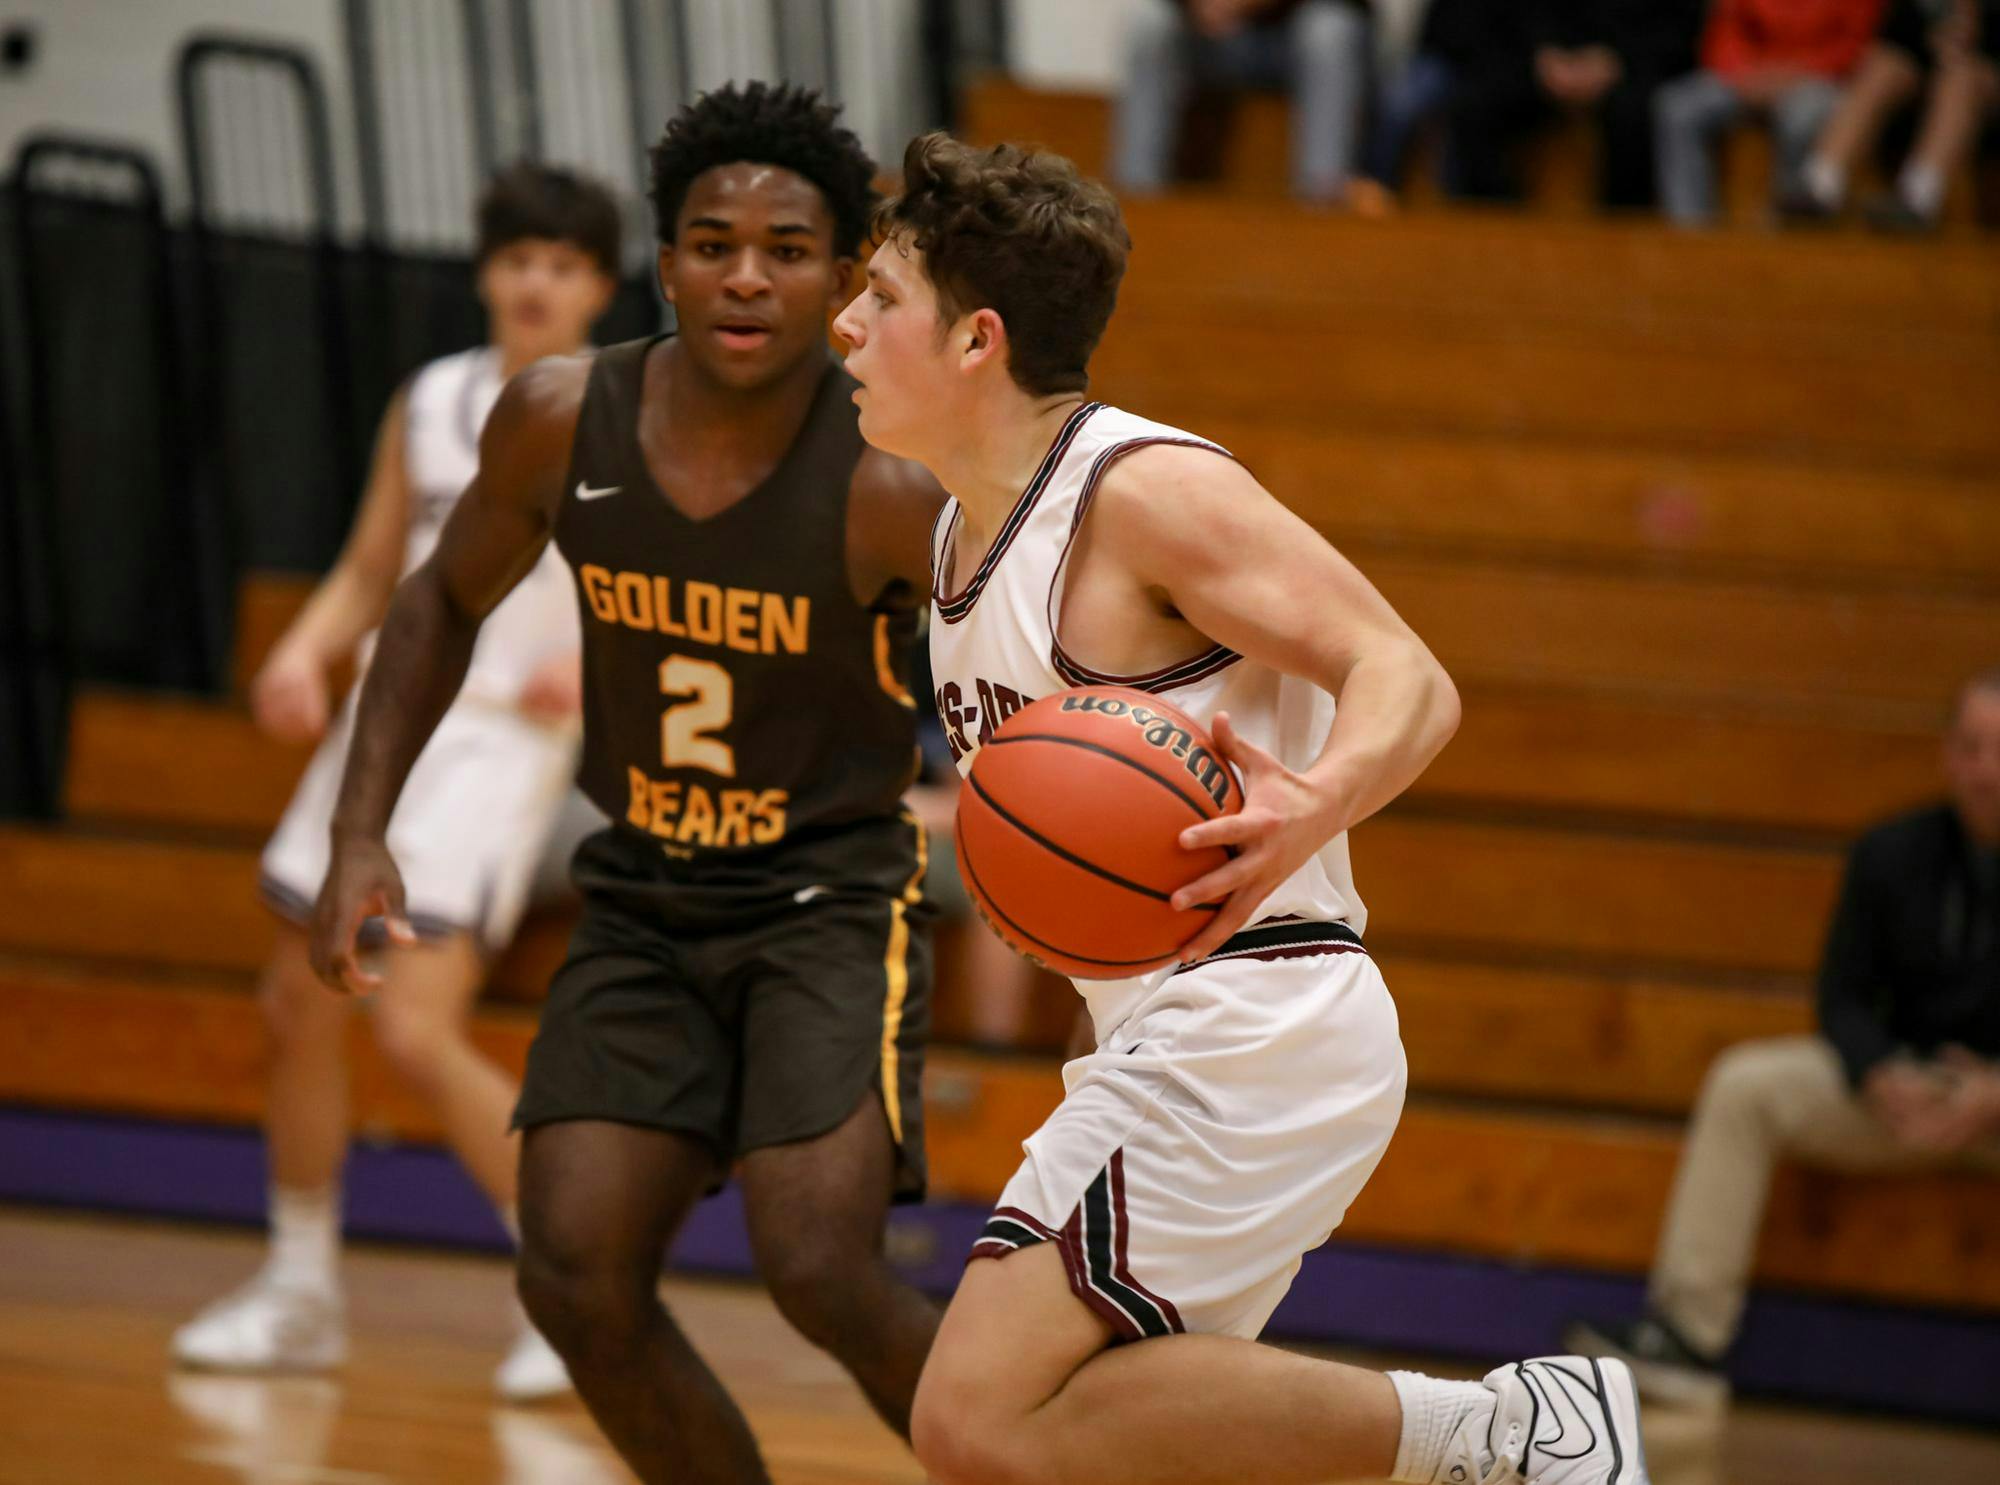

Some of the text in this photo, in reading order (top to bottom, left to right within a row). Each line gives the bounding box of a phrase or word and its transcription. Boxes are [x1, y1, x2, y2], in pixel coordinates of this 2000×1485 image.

[580, 563, 810, 655] GOLDEN
[657, 652, 736, 778] 2
[1061, 695, 1230, 812] Wilson
[625, 765, 789, 847] BEARS
